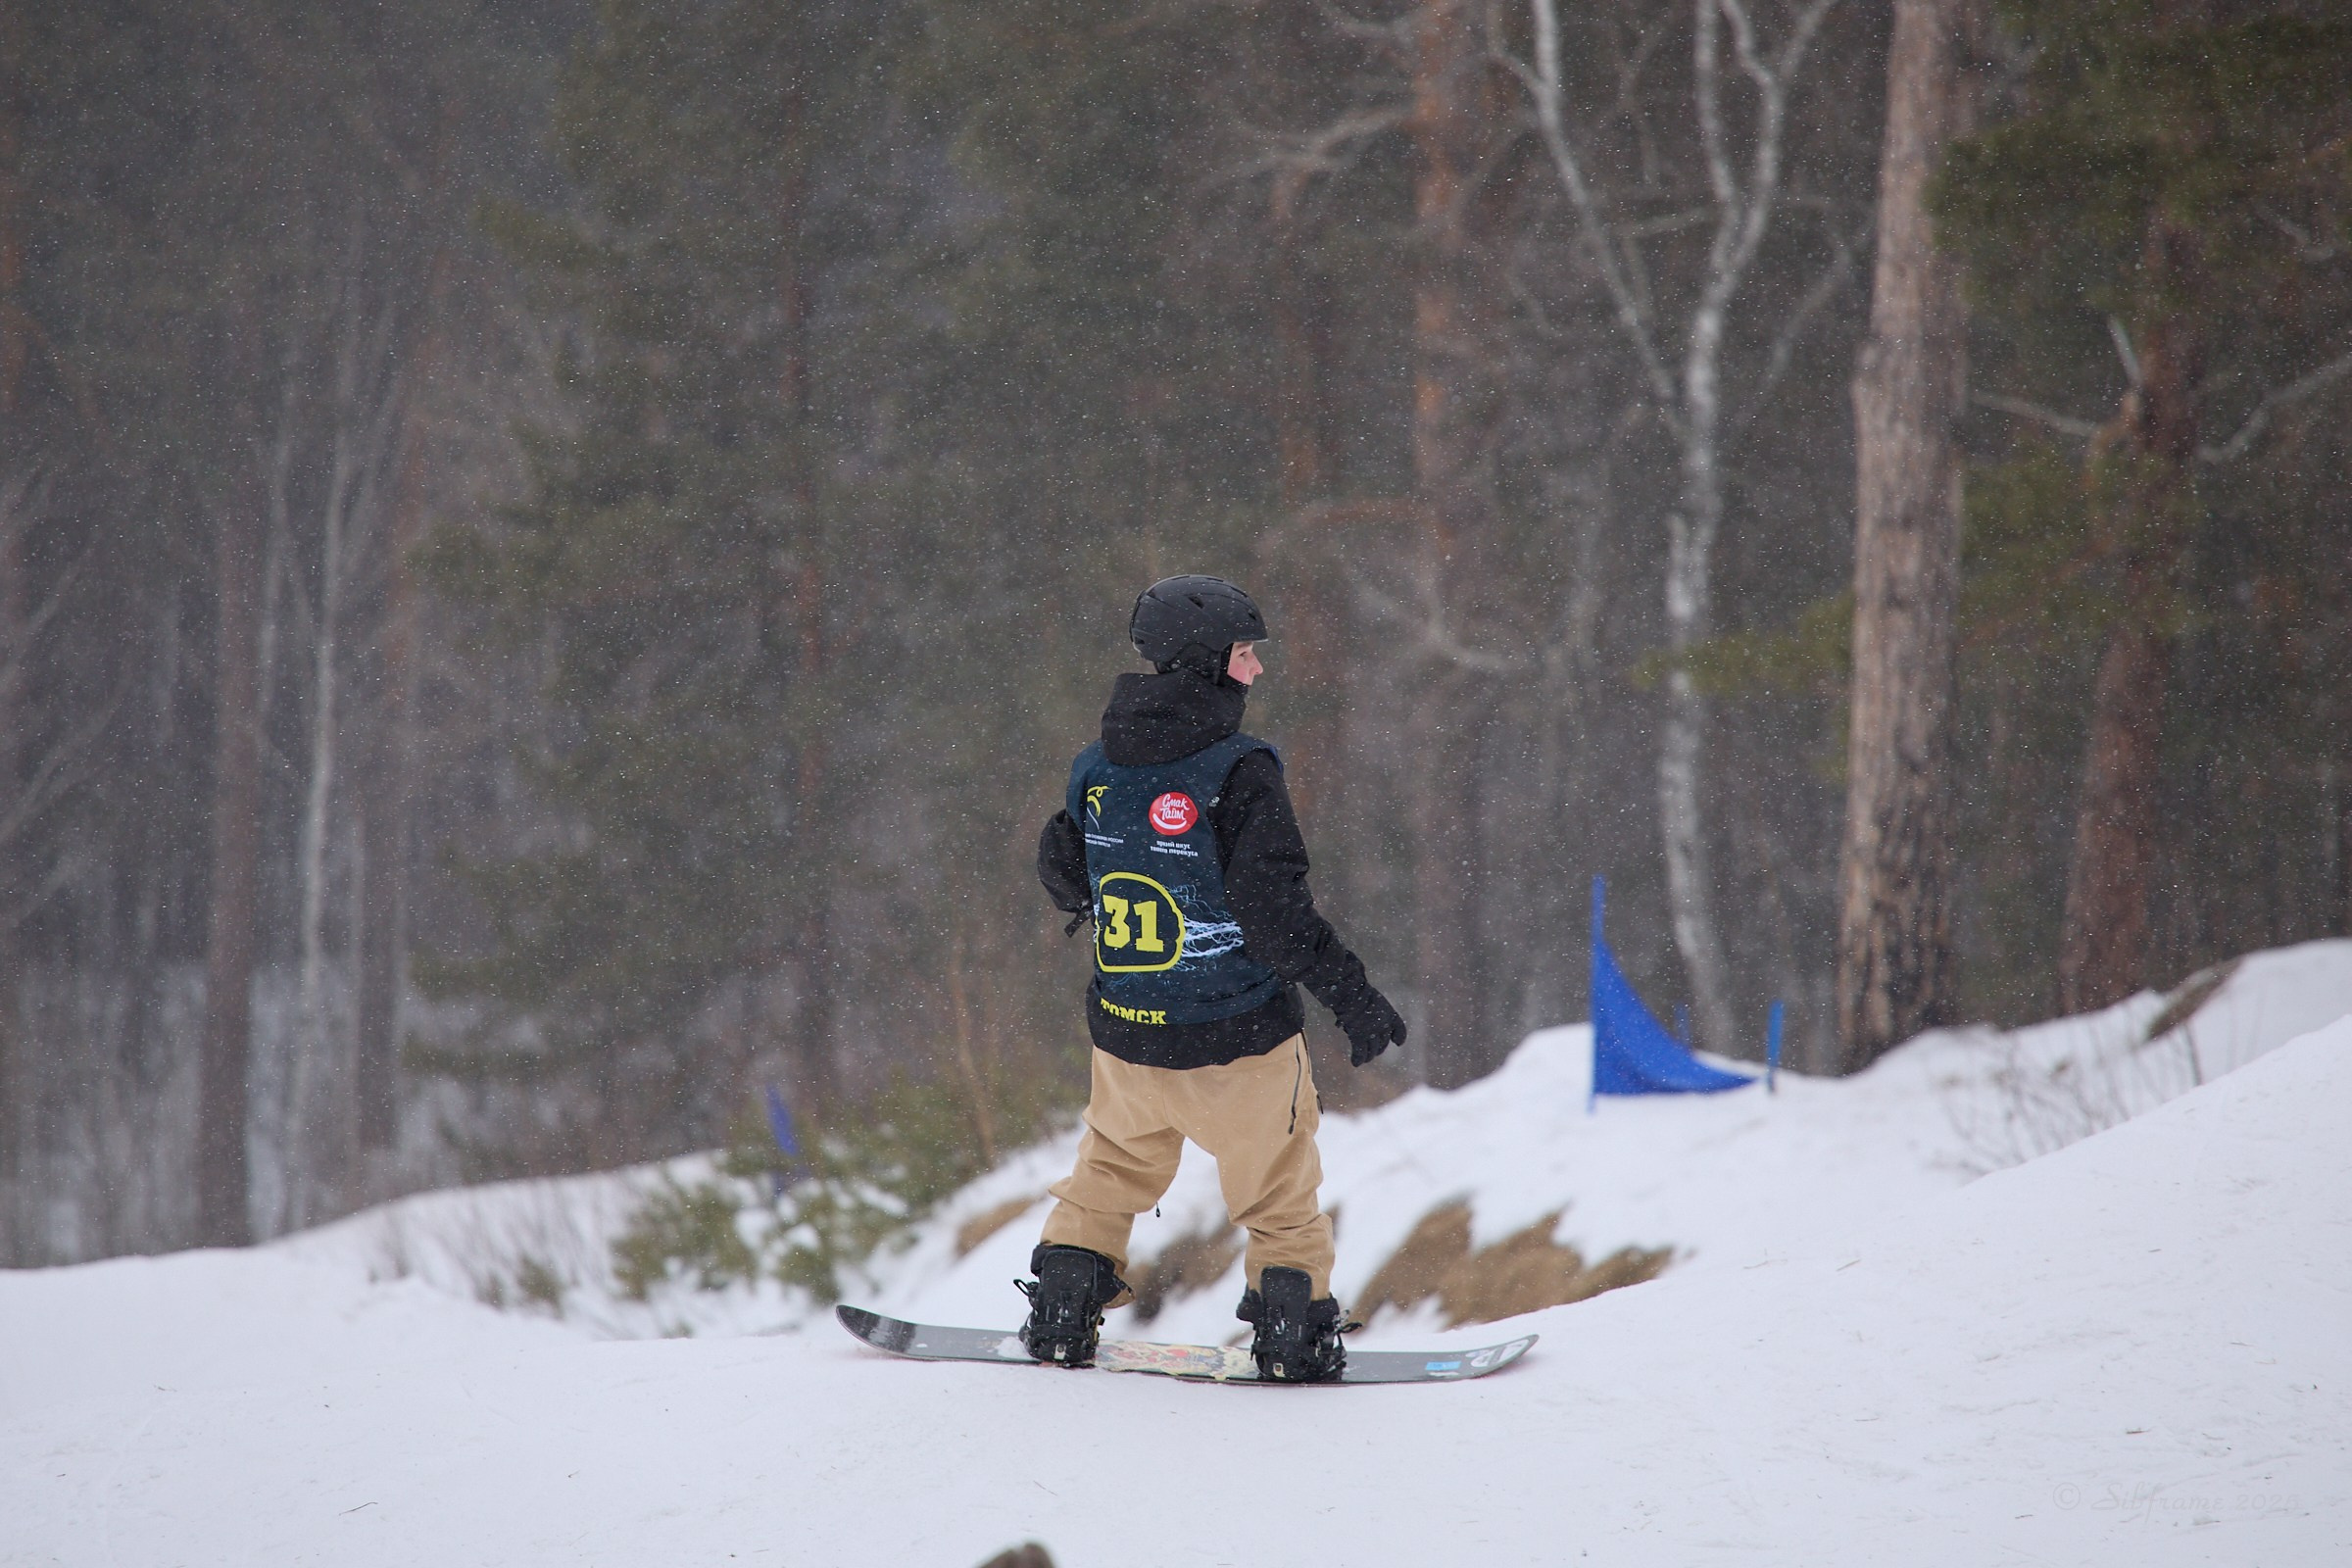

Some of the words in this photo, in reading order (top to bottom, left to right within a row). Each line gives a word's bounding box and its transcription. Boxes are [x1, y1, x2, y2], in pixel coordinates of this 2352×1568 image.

[1162, 794, 1190, 810] Смак
[1160, 808, 1187, 820] Тайм
[1102, 895, 1164, 953] 31
[1100, 997, 1169, 1025] ТОМСК
